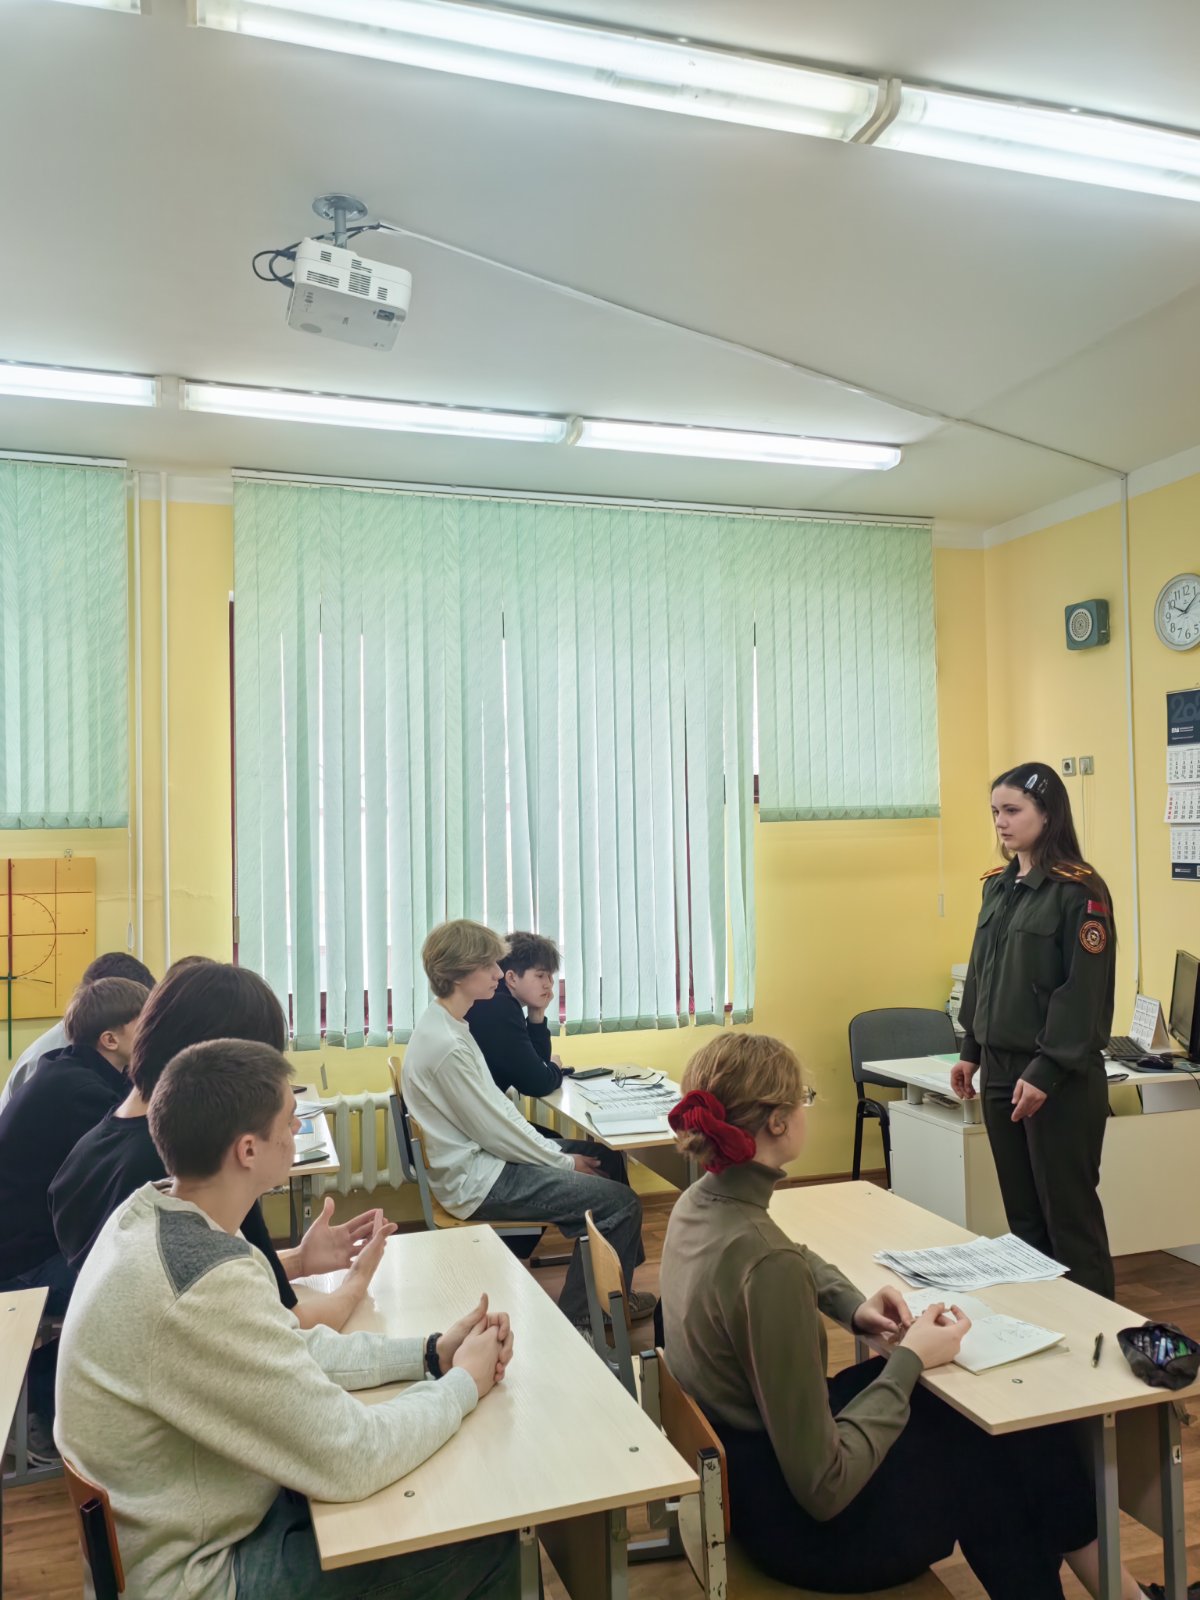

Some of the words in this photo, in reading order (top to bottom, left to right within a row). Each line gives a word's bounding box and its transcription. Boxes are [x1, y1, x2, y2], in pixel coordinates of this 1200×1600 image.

[1174, 590, 1181, 600] 11
[1183, 585, 1190, 596] 12
[1168, 600, 1176, 610] 10
[1165, 612, 1171, 623] 9
[1170, 622, 1176, 633] 8
[1177, 627, 1183, 639] 7
[1193, 624, 1199, 635] 5
[1185, 628, 1191, 640] 6
